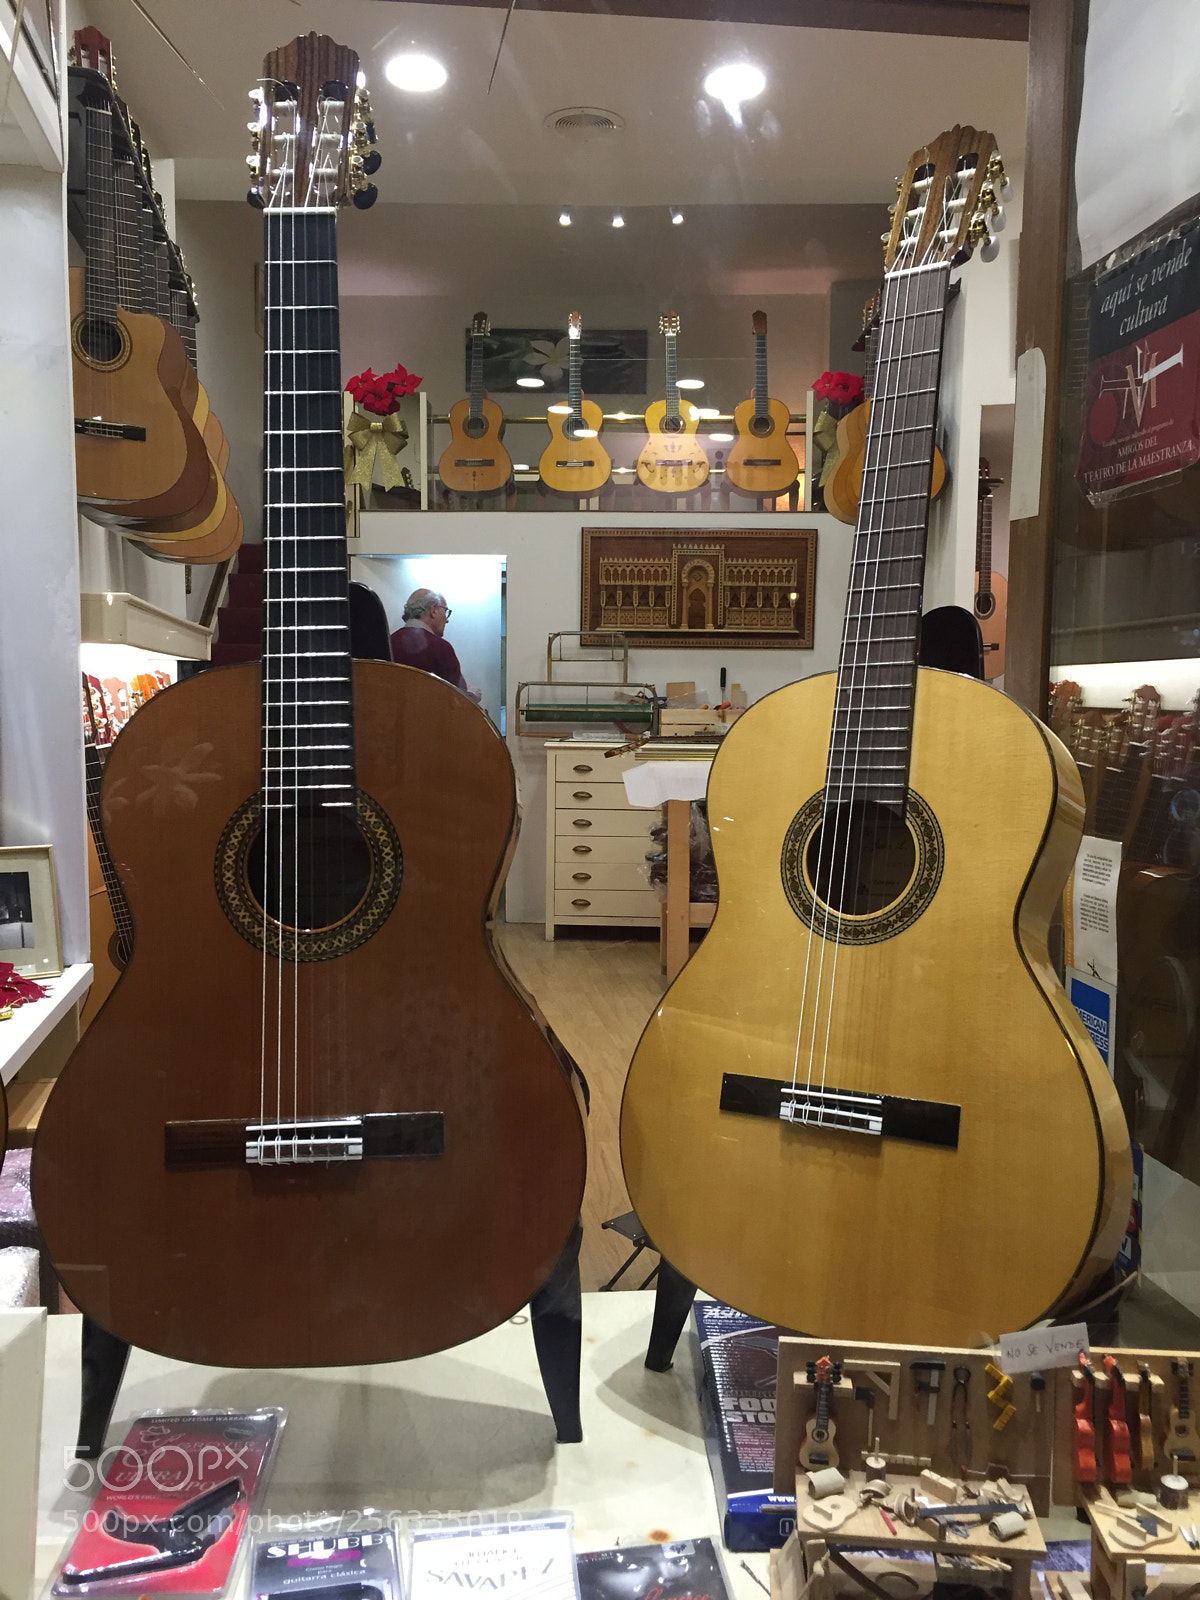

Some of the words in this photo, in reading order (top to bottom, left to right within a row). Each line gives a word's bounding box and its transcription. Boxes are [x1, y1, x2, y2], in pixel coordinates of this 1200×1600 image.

[1100, 274, 1134, 318] aquí
[1135, 273, 1148, 295] se
[1151, 238, 1192, 286] vende
[1119, 295, 1169, 336] cultura
[1117, 443, 1144, 458] AMIGOS
[1144, 436, 1158, 449] DEL
[1083, 465, 1115, 483] TEATRO
[1115, 461, 1127, 475] DE
[1127, 459, 1138, 471] LA
[1138, 439, 1193, 467] MAESTRANZA
[1006, 1347, 1021, 1359] NO
[1027, 1343, 1039, 1357] SE
[1045, 1335, 1085, 1354] VENDE
[722, 1397, 776, 1411] FOO
[151, 1416, 181, 1424] LIMITED
[182, 1415, 215, 1423] LIFETIME
[215, 1414, 264, 1422] WARRAN
[725, 1411, 776, 1424] STO
[266, 1534, 384, 1559] SHUBB
[282, 1573, 327, 1585] guitarra
[330, 1568, 366, 1579] clásica
